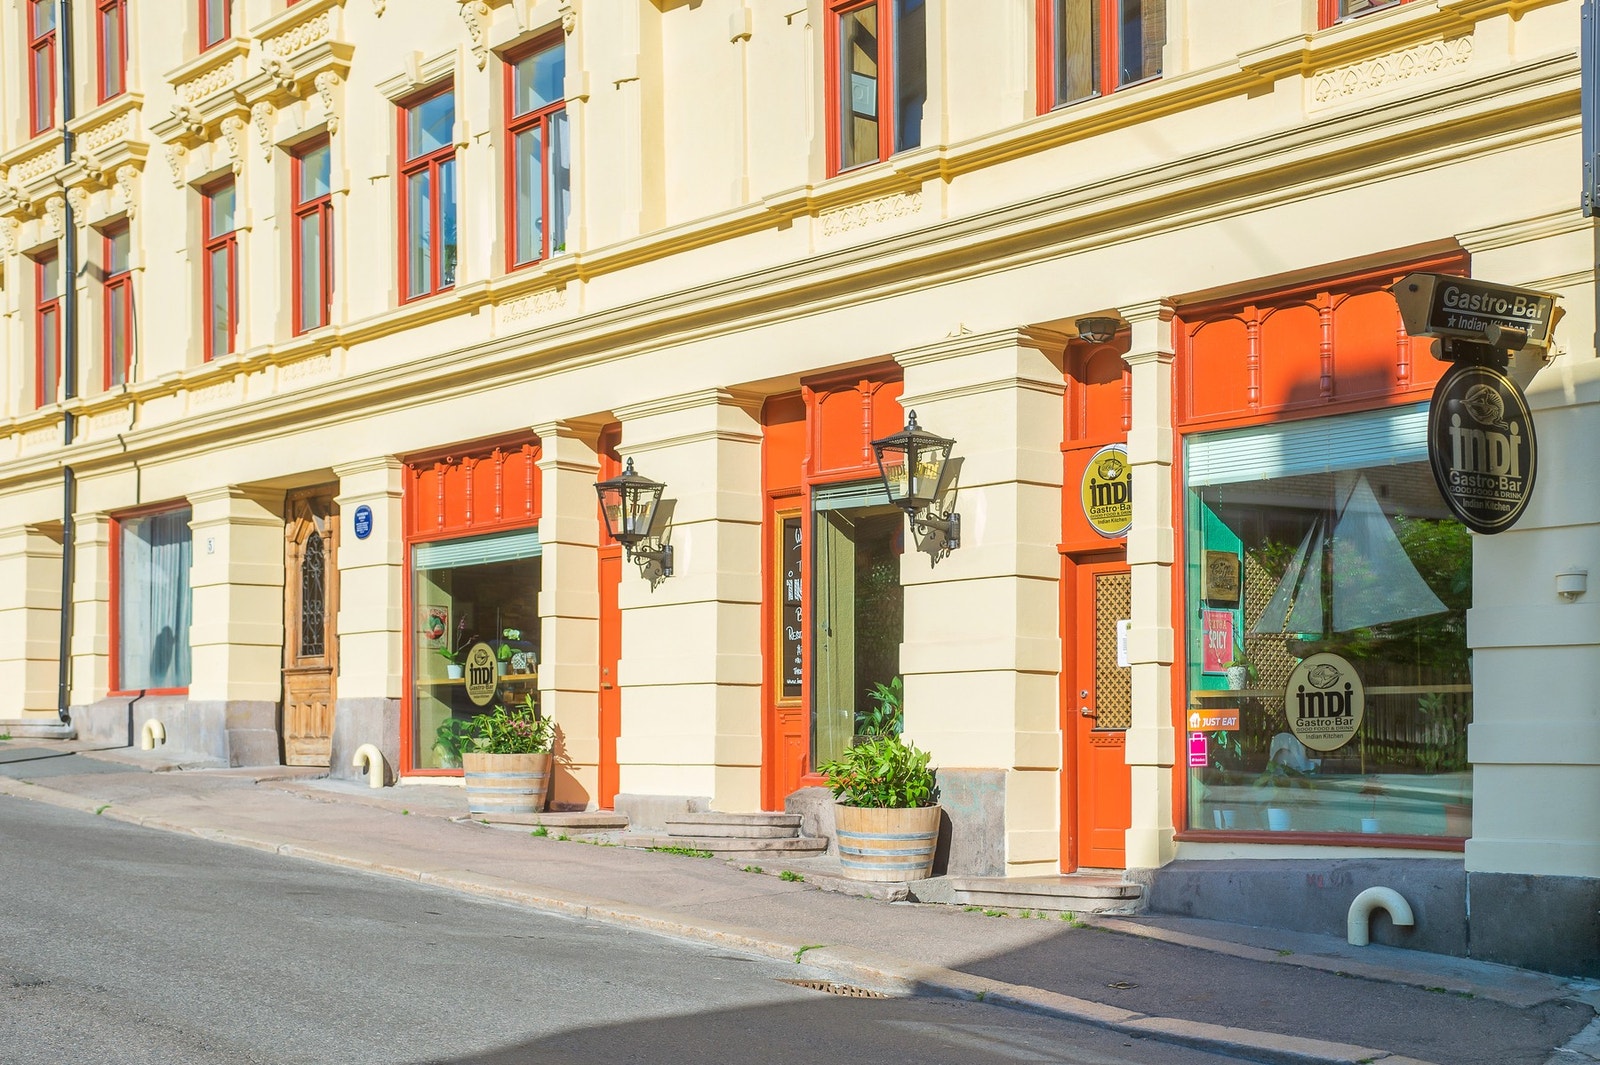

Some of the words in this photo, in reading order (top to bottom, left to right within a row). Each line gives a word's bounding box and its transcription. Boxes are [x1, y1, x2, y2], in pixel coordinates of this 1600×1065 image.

[1458, 315, 1488, 332] Indian
[1449, 485, 1472, 494] GOOD
[1473, 488, 1495, 496] FOOD
[1500, 491, 1522, 499] DRINK
[1463, 498, 1484, 508] Indian
[1485, 499, 1511, 512] Kitchen
[1209, 631, 1228, 650] SPICY
[1202, 717, 1221, 727] JUST
[1222, 717, 1237, 726] EAT
